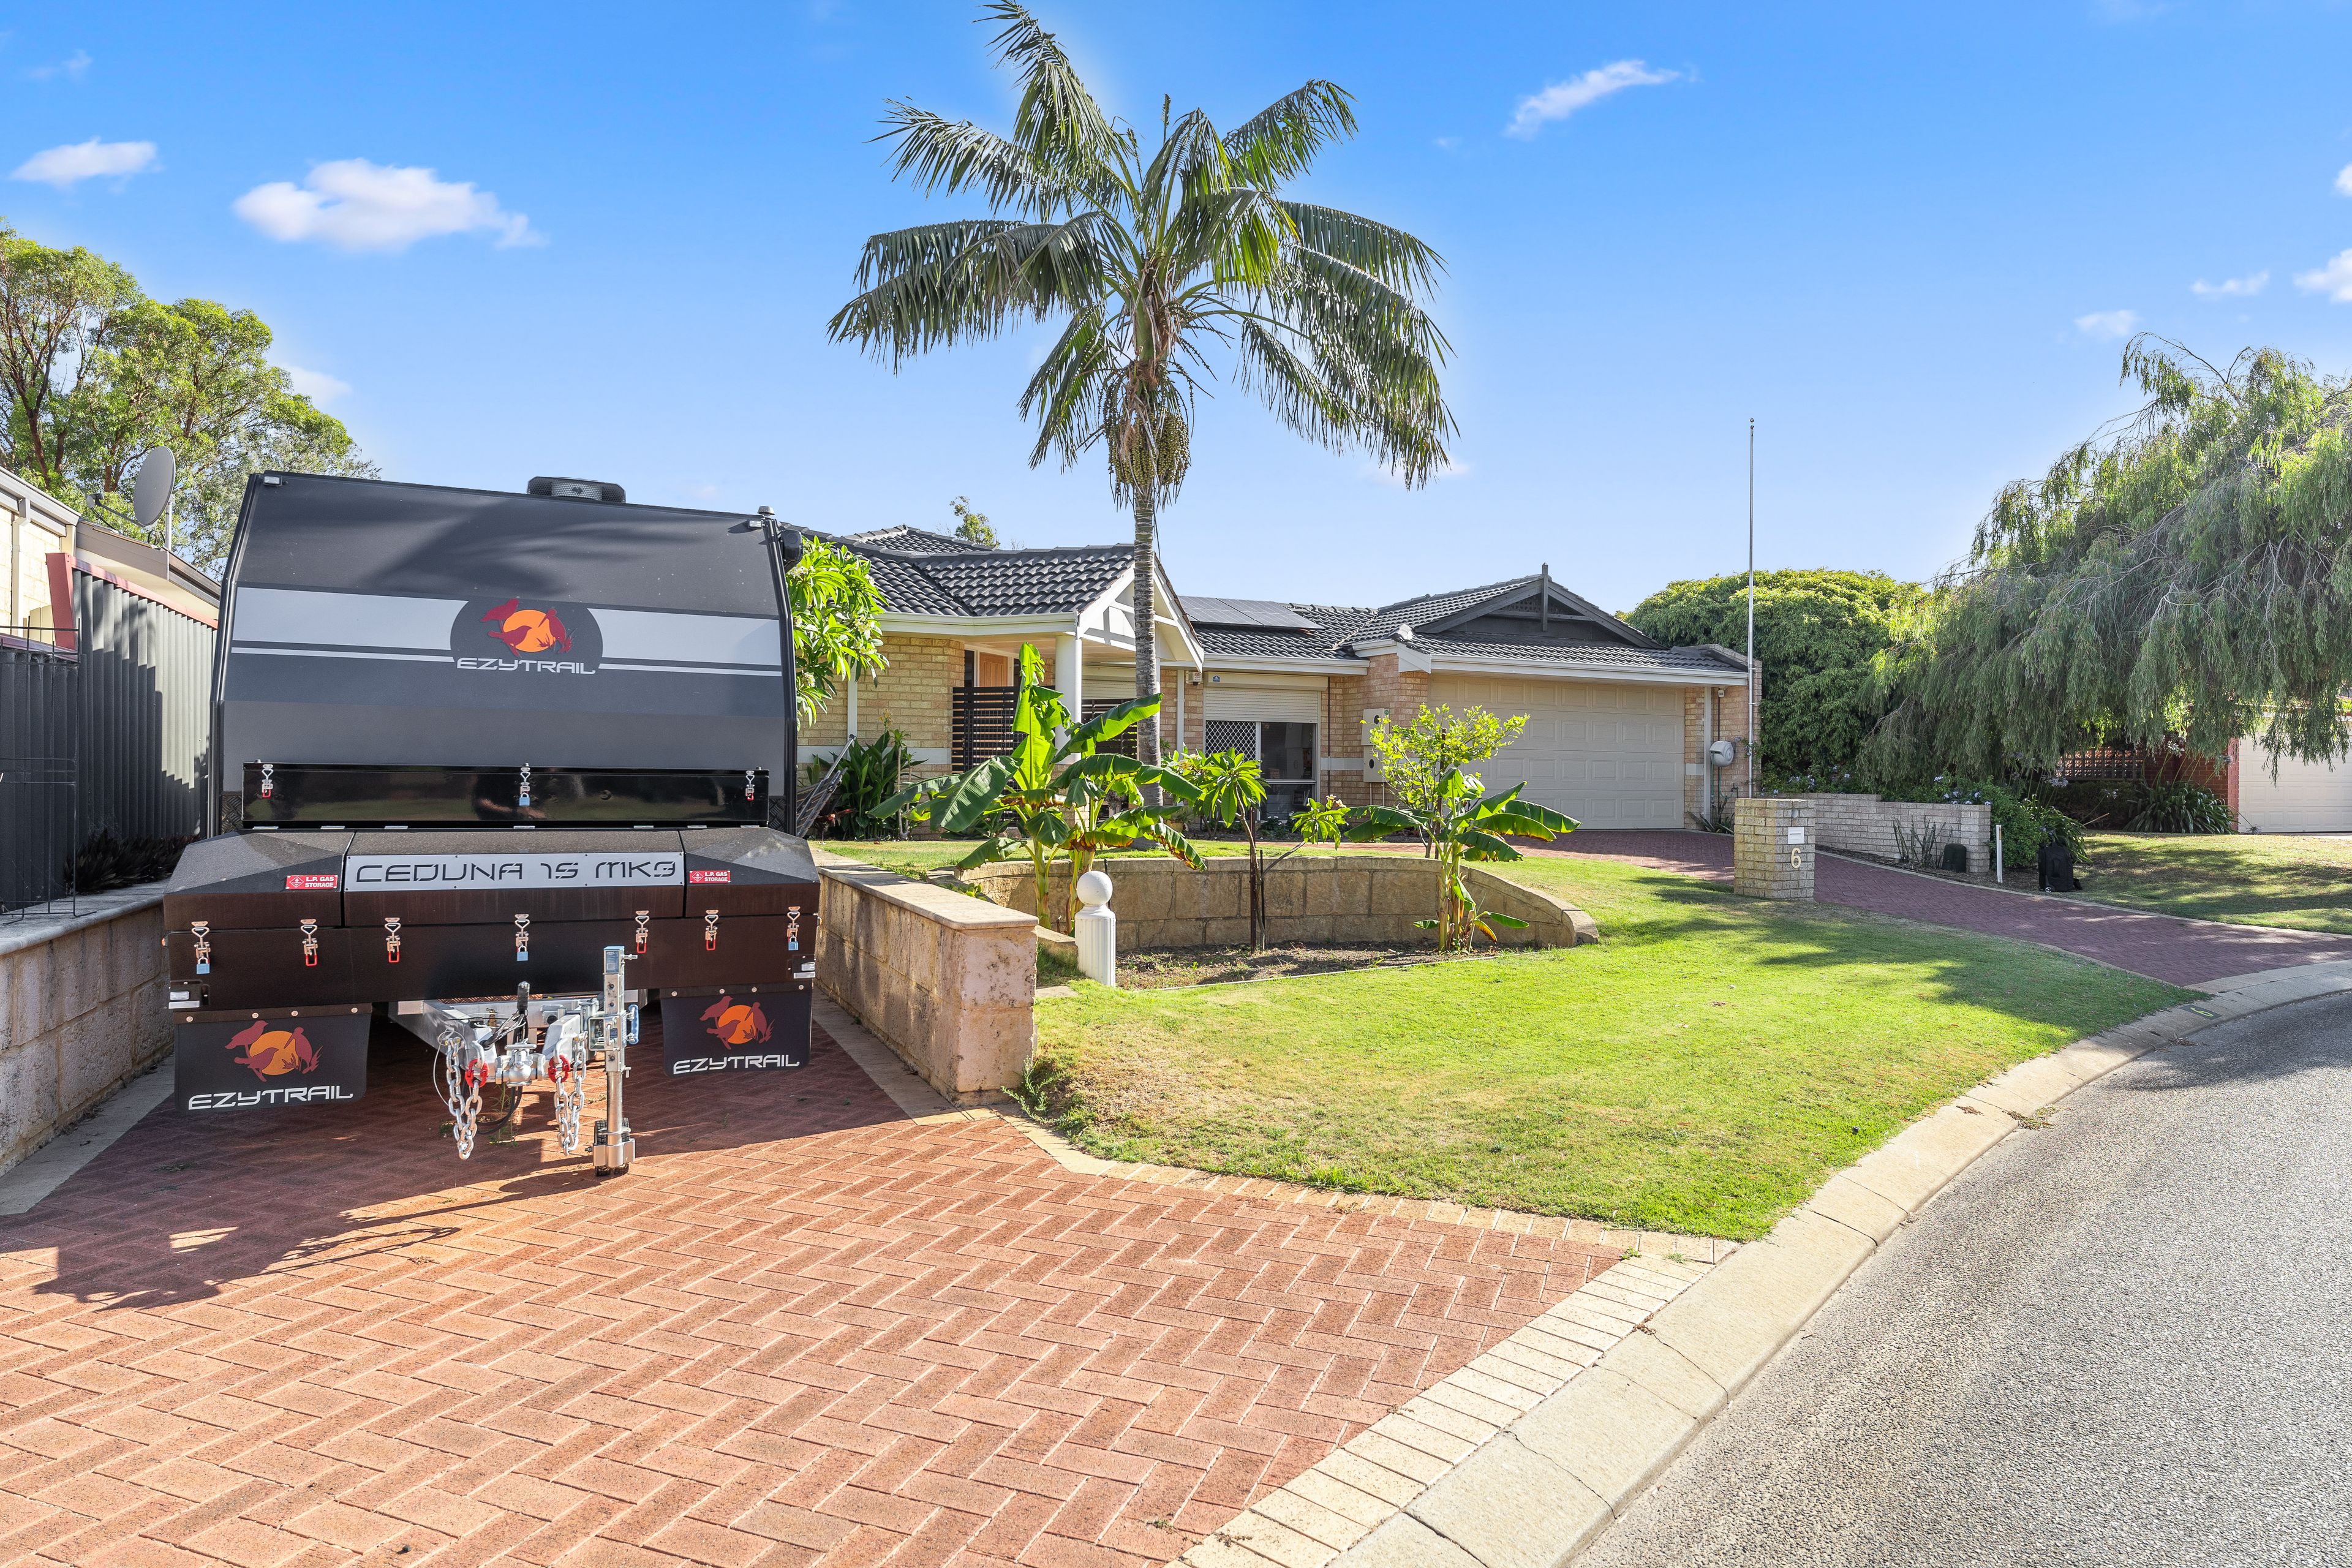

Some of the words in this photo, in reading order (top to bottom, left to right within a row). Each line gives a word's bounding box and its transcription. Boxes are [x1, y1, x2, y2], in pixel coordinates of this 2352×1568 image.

[456, 657, 596, 674] EZYTRAIL
[1791, 847, 1802, 869] 6
[356, 862, 522, 882] CEDUNA
[673, 1054, 800, 1074] EZYTRAIL
[188, 1085, 353, 1110] EZYTRAIL
